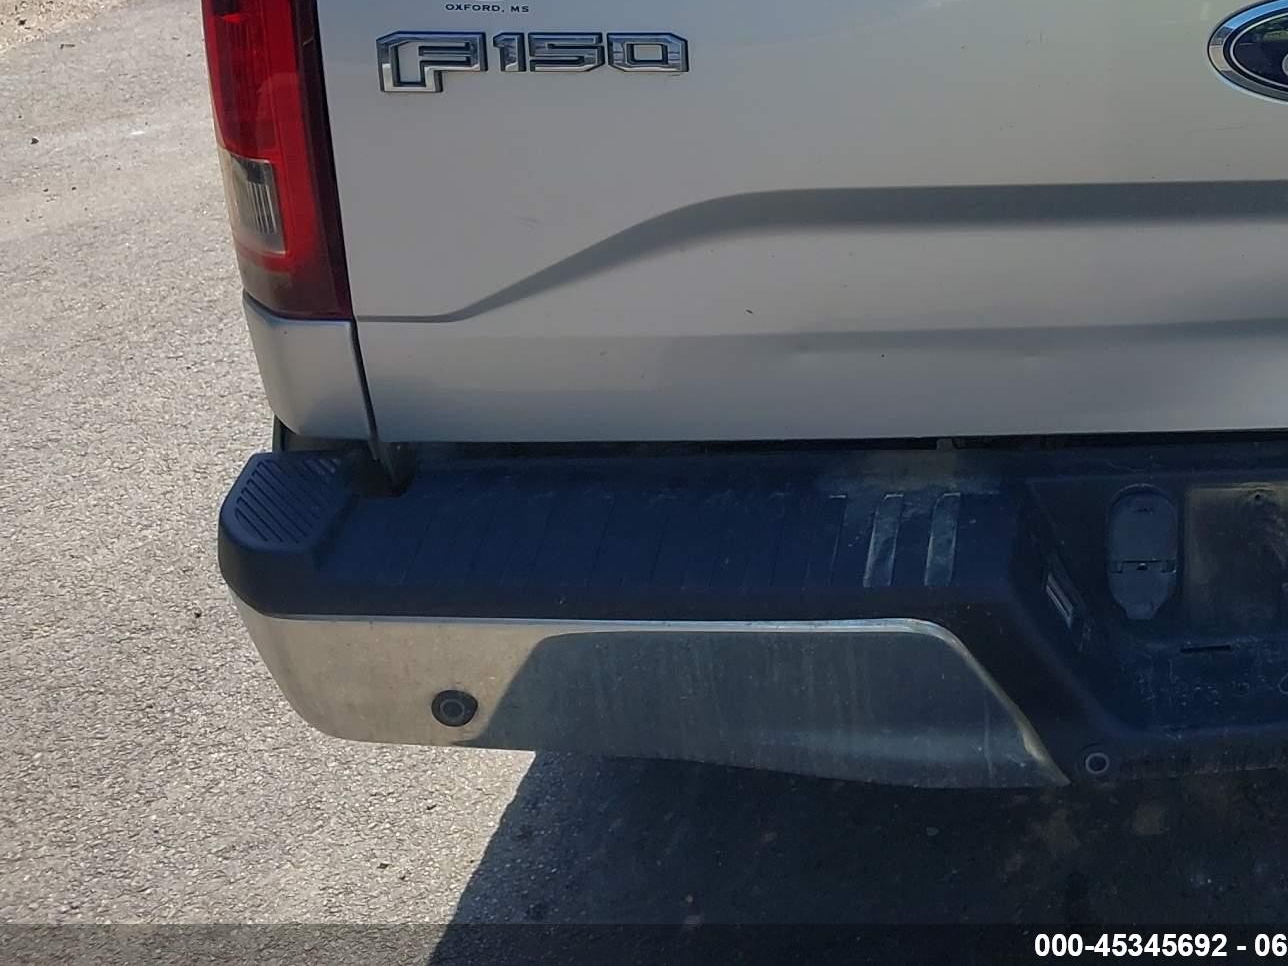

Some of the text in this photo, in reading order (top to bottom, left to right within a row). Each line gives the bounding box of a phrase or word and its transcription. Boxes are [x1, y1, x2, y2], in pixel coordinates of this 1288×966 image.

[445, 3, 529, 13] OXFORD, MS
[376, 31, 690, 93] F150
